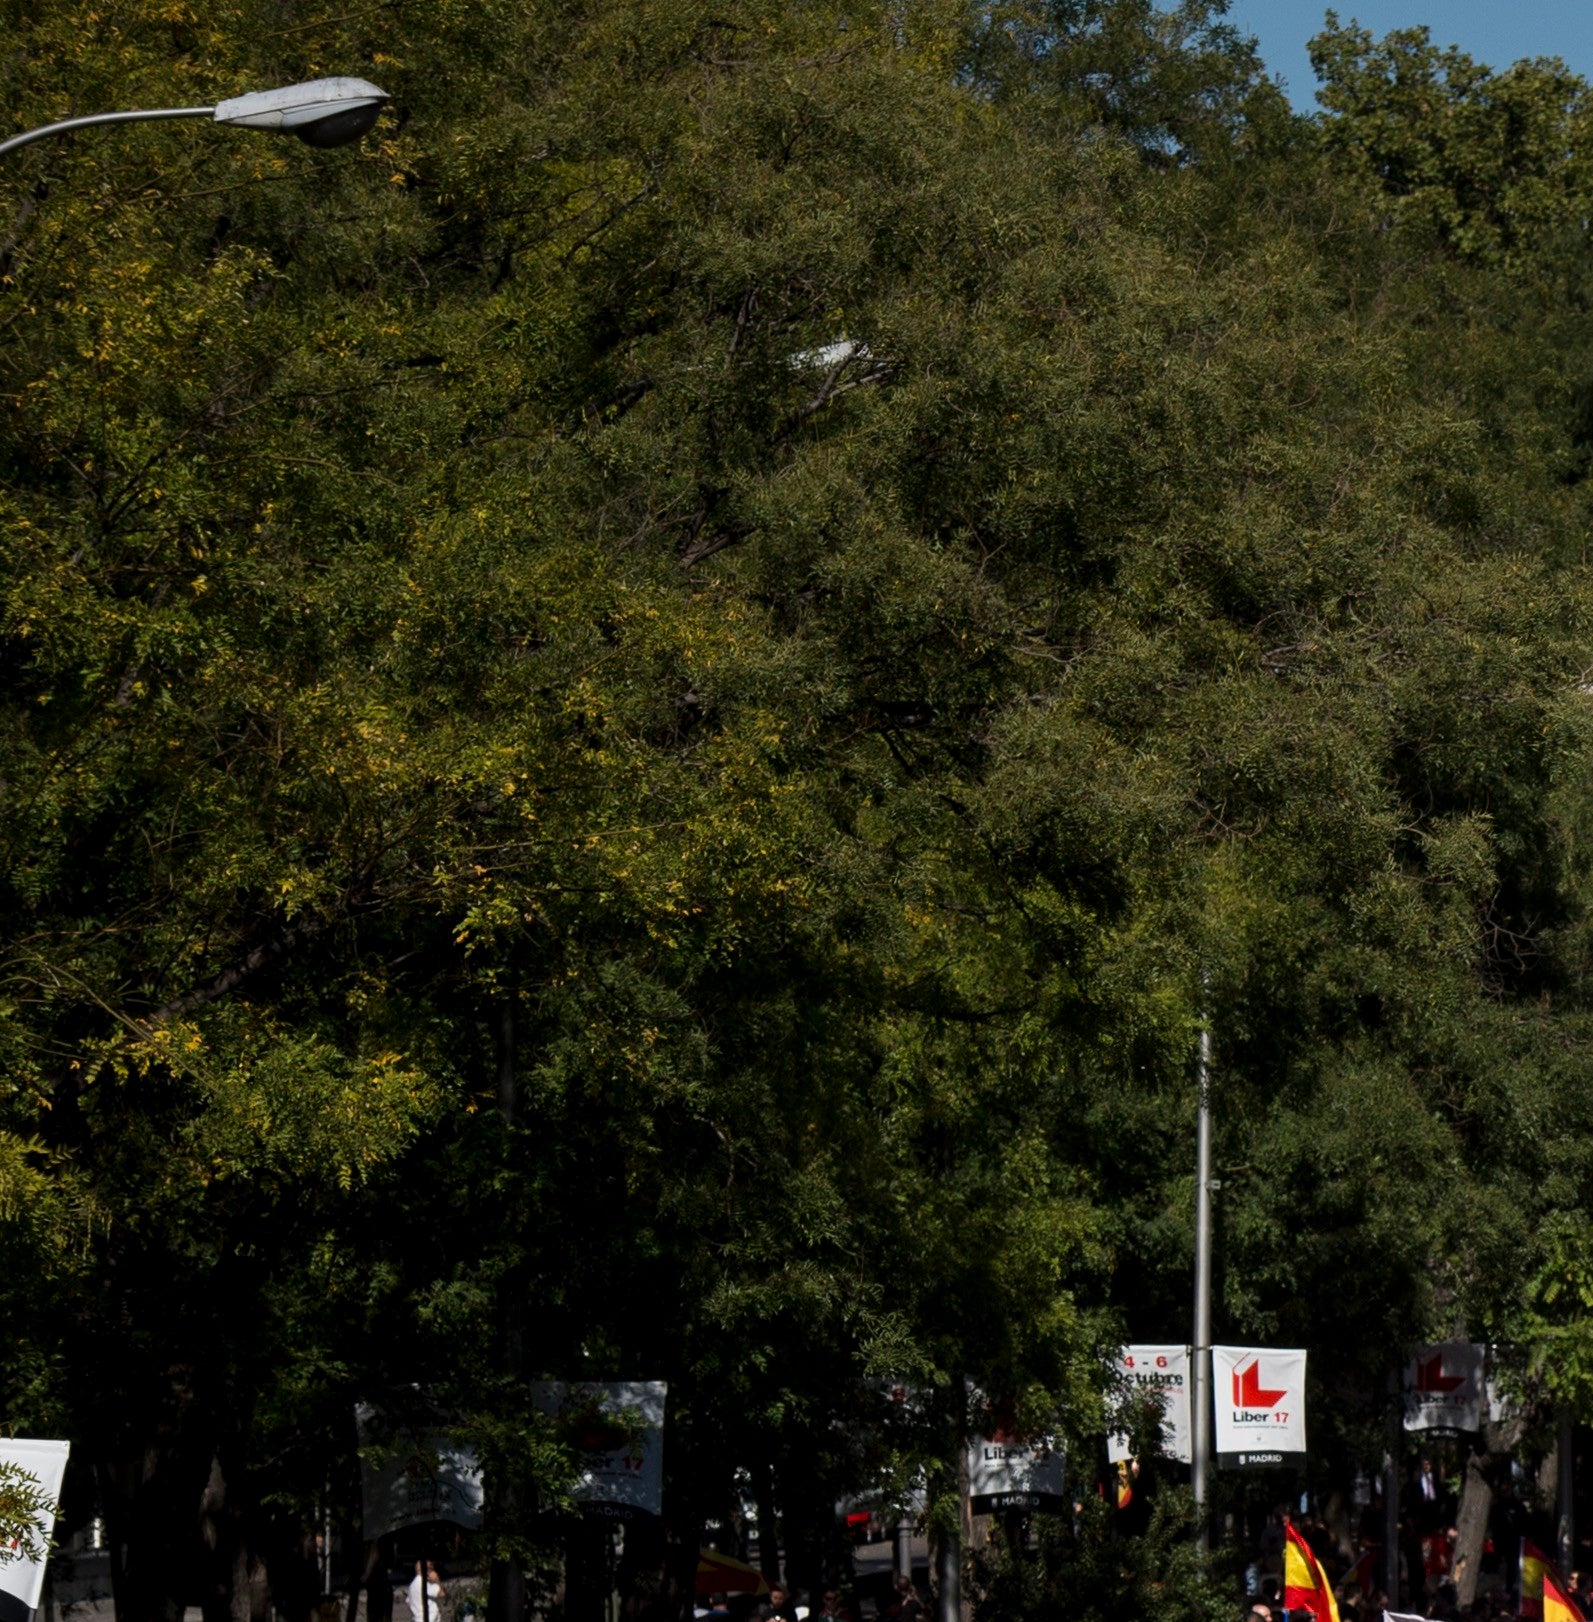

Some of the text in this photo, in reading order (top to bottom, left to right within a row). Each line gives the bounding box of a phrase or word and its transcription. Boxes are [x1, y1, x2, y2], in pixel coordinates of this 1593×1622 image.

[1123, 1356, 1168, 1368] 4 6
[1233, 1411, 1289, 1424] Liber 17
[1248, 1453, 1282, 1464] MADRID
